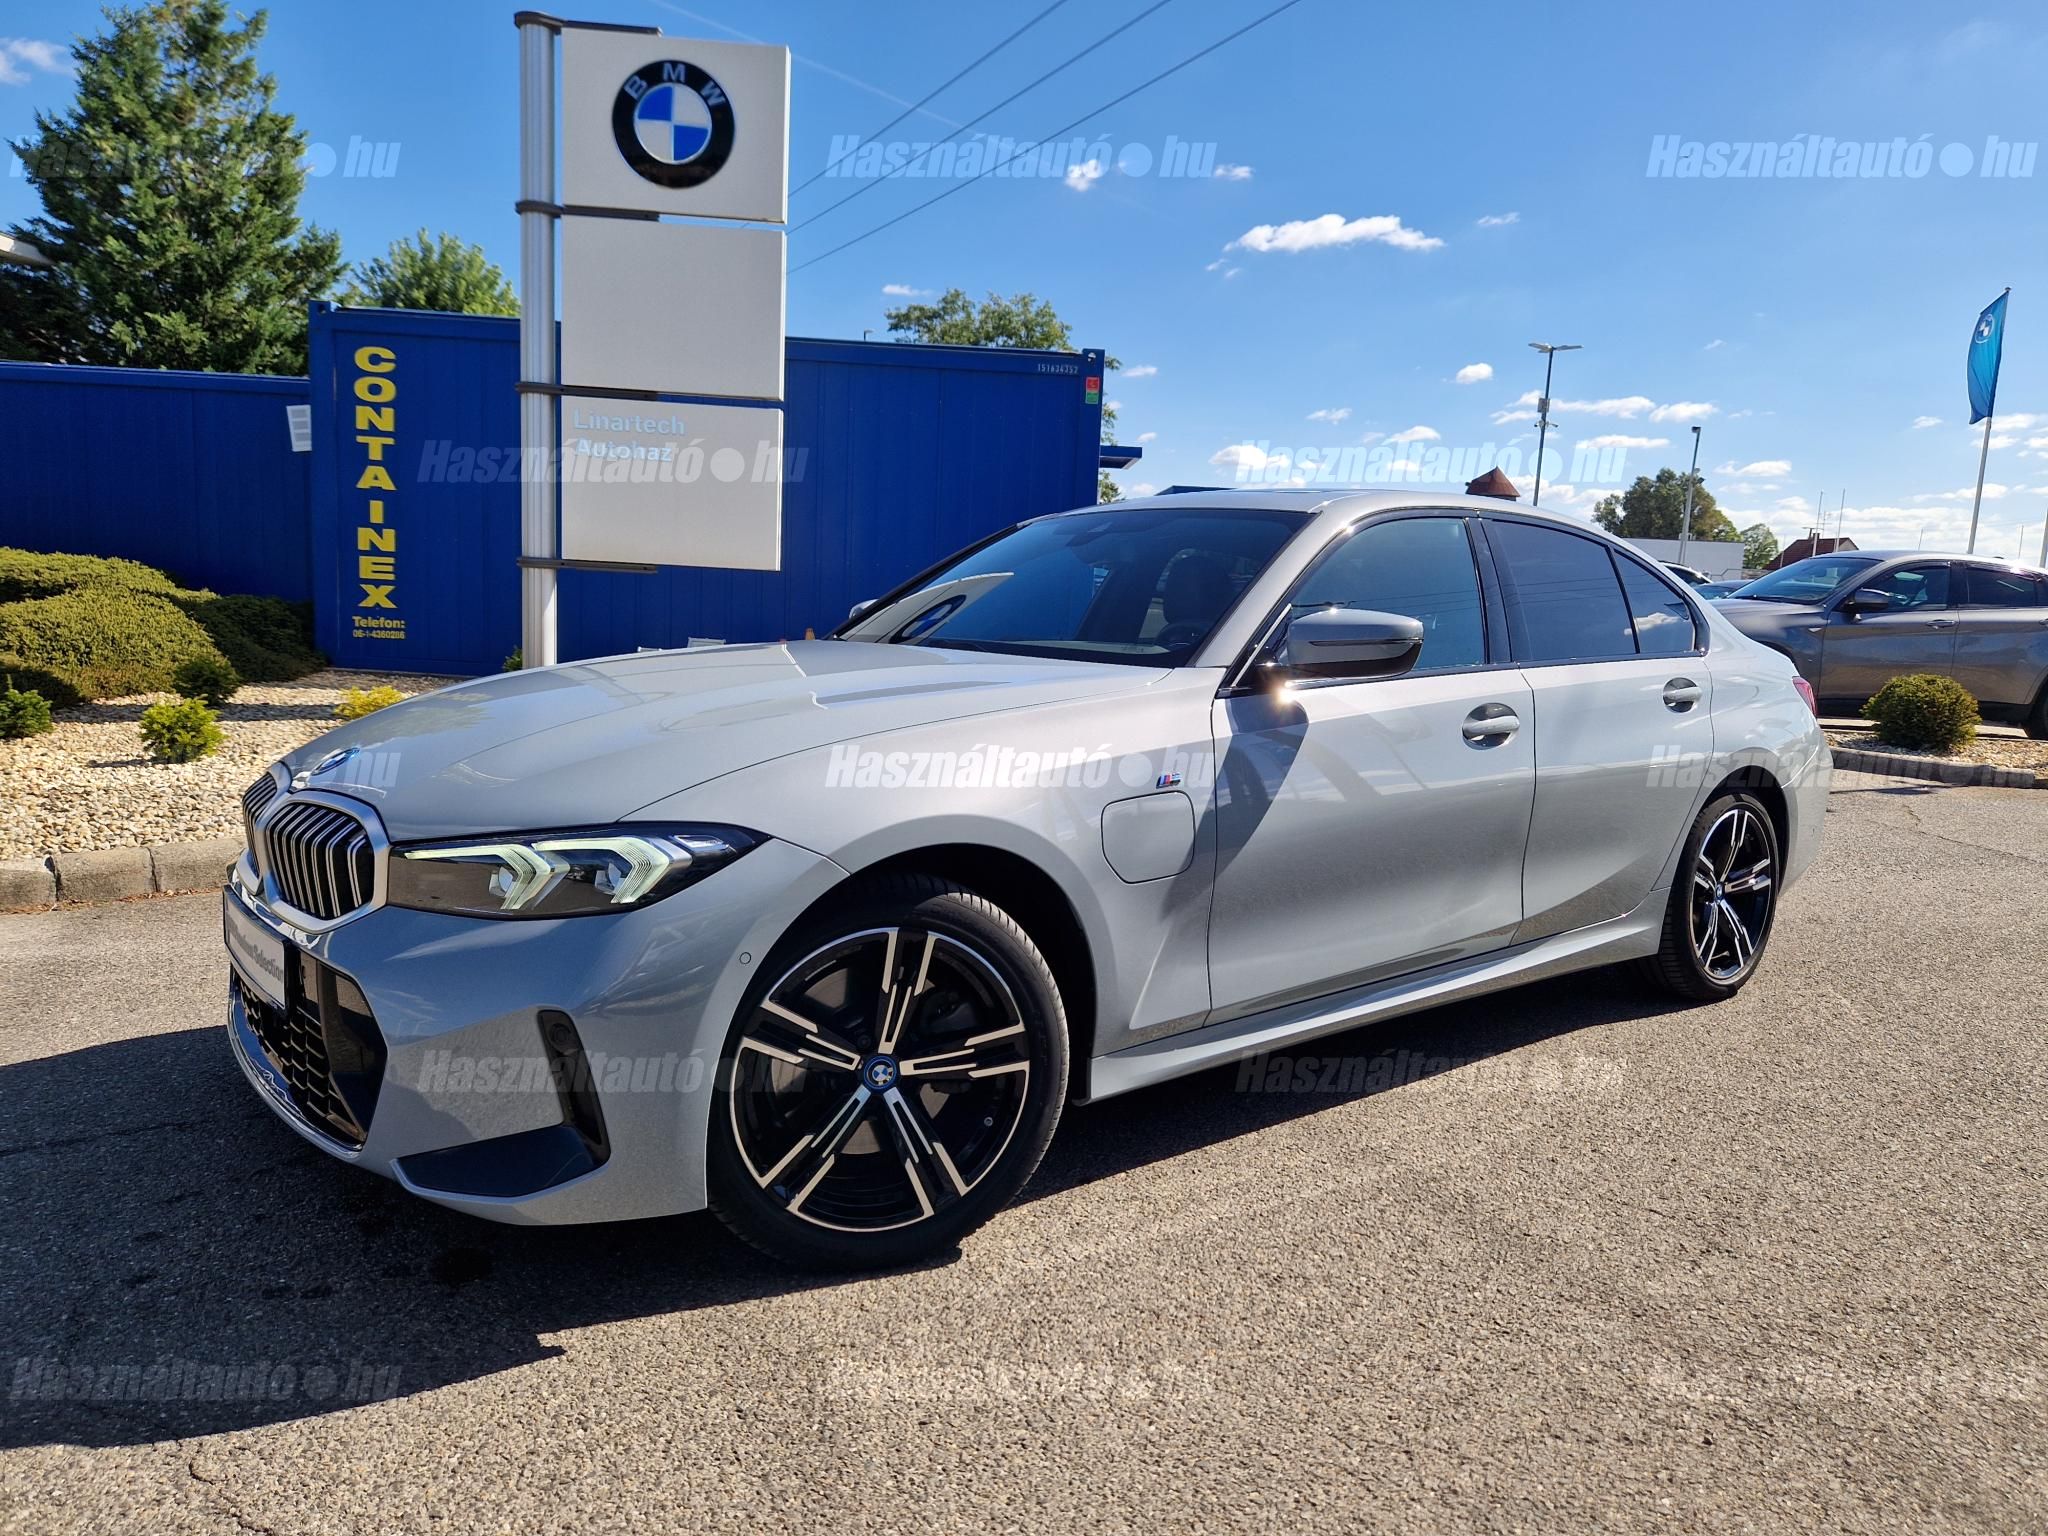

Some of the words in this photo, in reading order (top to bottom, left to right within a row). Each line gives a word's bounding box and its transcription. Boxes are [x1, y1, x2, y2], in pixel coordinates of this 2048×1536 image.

[624, 62, 726, 106] BMW
[574, 409, 685, 434] Linartech
[353, 346, 397, 608] CONTAINEX
[352, 615, 406, 629] Telefon:
